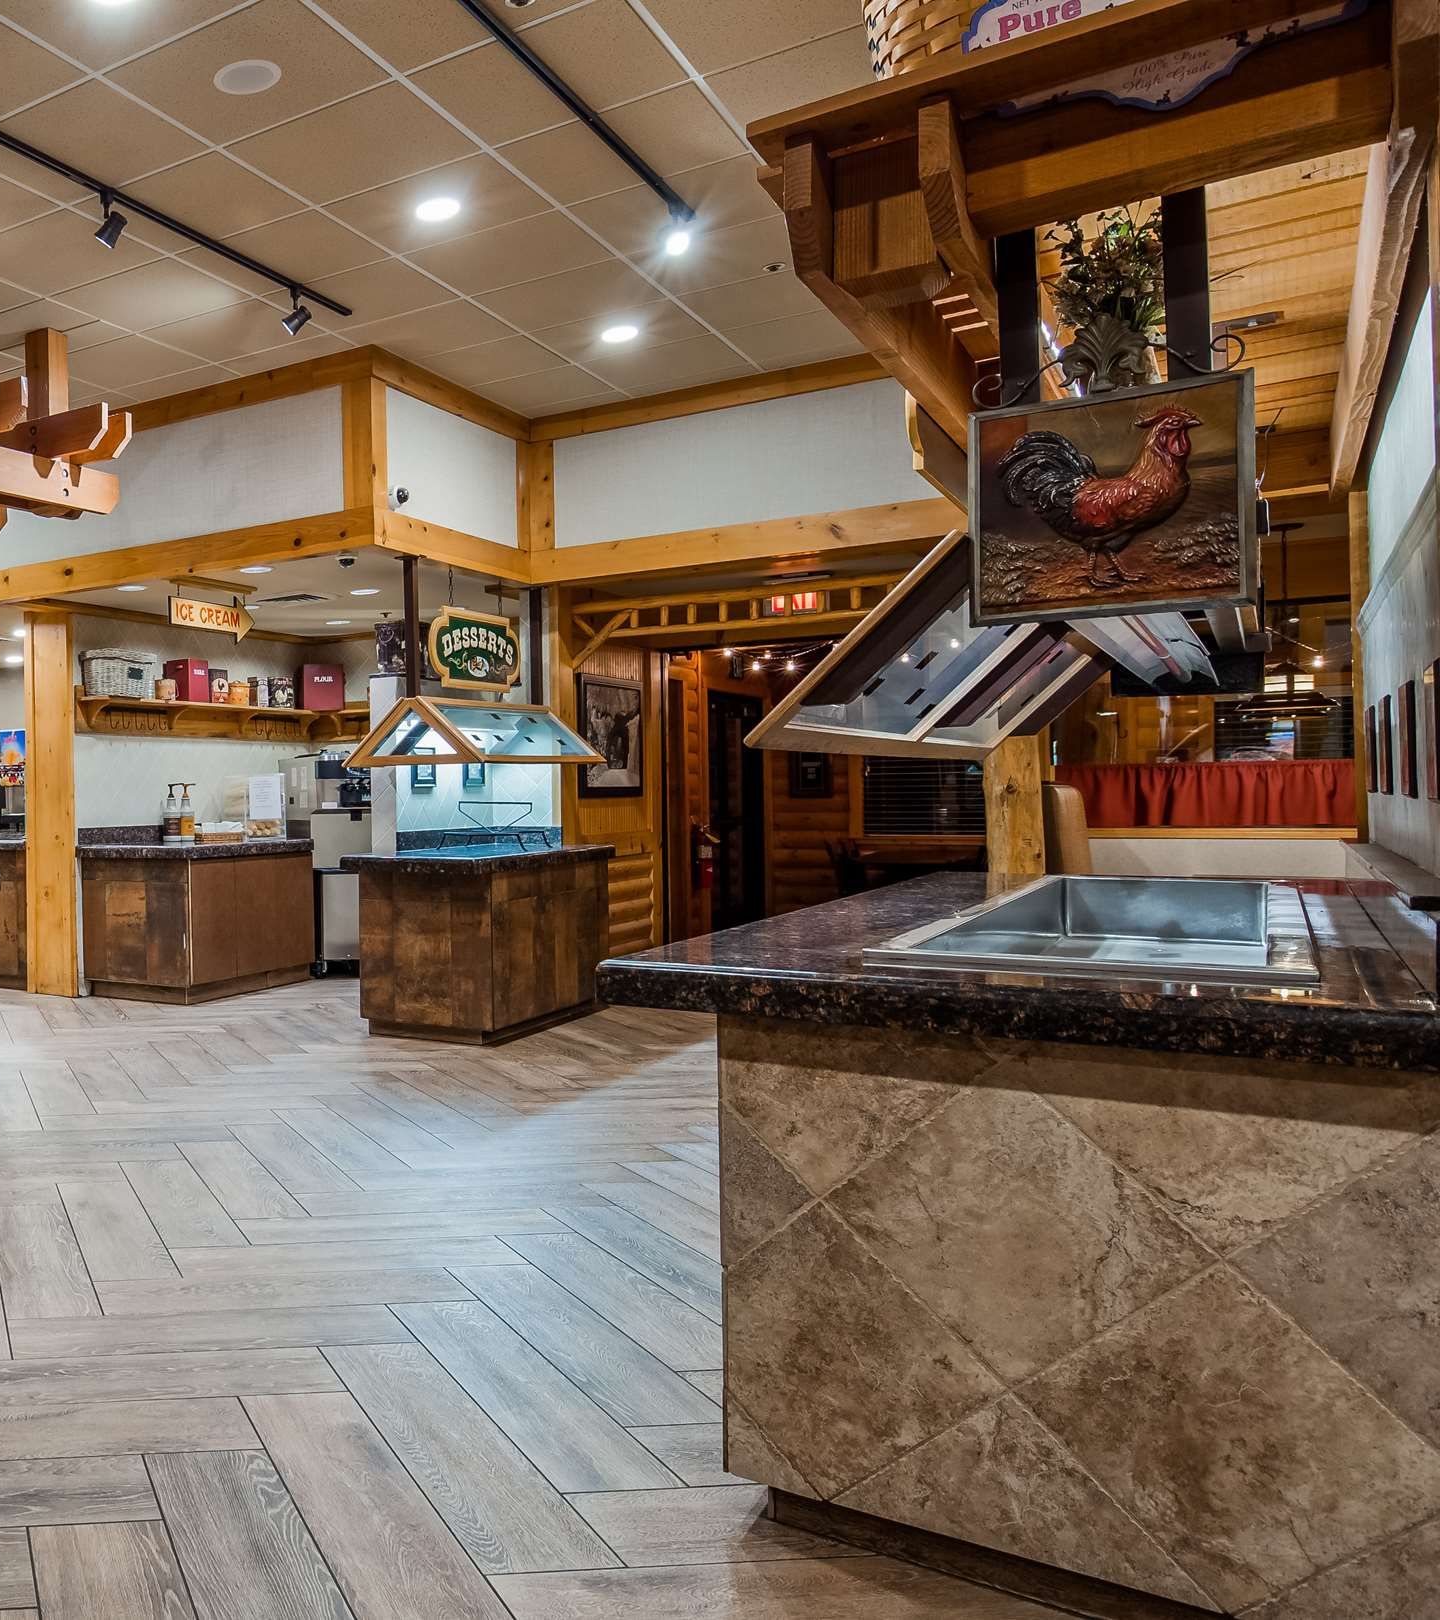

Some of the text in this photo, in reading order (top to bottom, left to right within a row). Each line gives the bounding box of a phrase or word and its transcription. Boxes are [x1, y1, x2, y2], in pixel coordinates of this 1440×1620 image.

[998, 0, 1082, 40] Pure
[1132, 60, 1168, 78] 100%
[175, 602, 241, 628] ICE CREAM
[441, 626, 514, 667] DESSERTS
